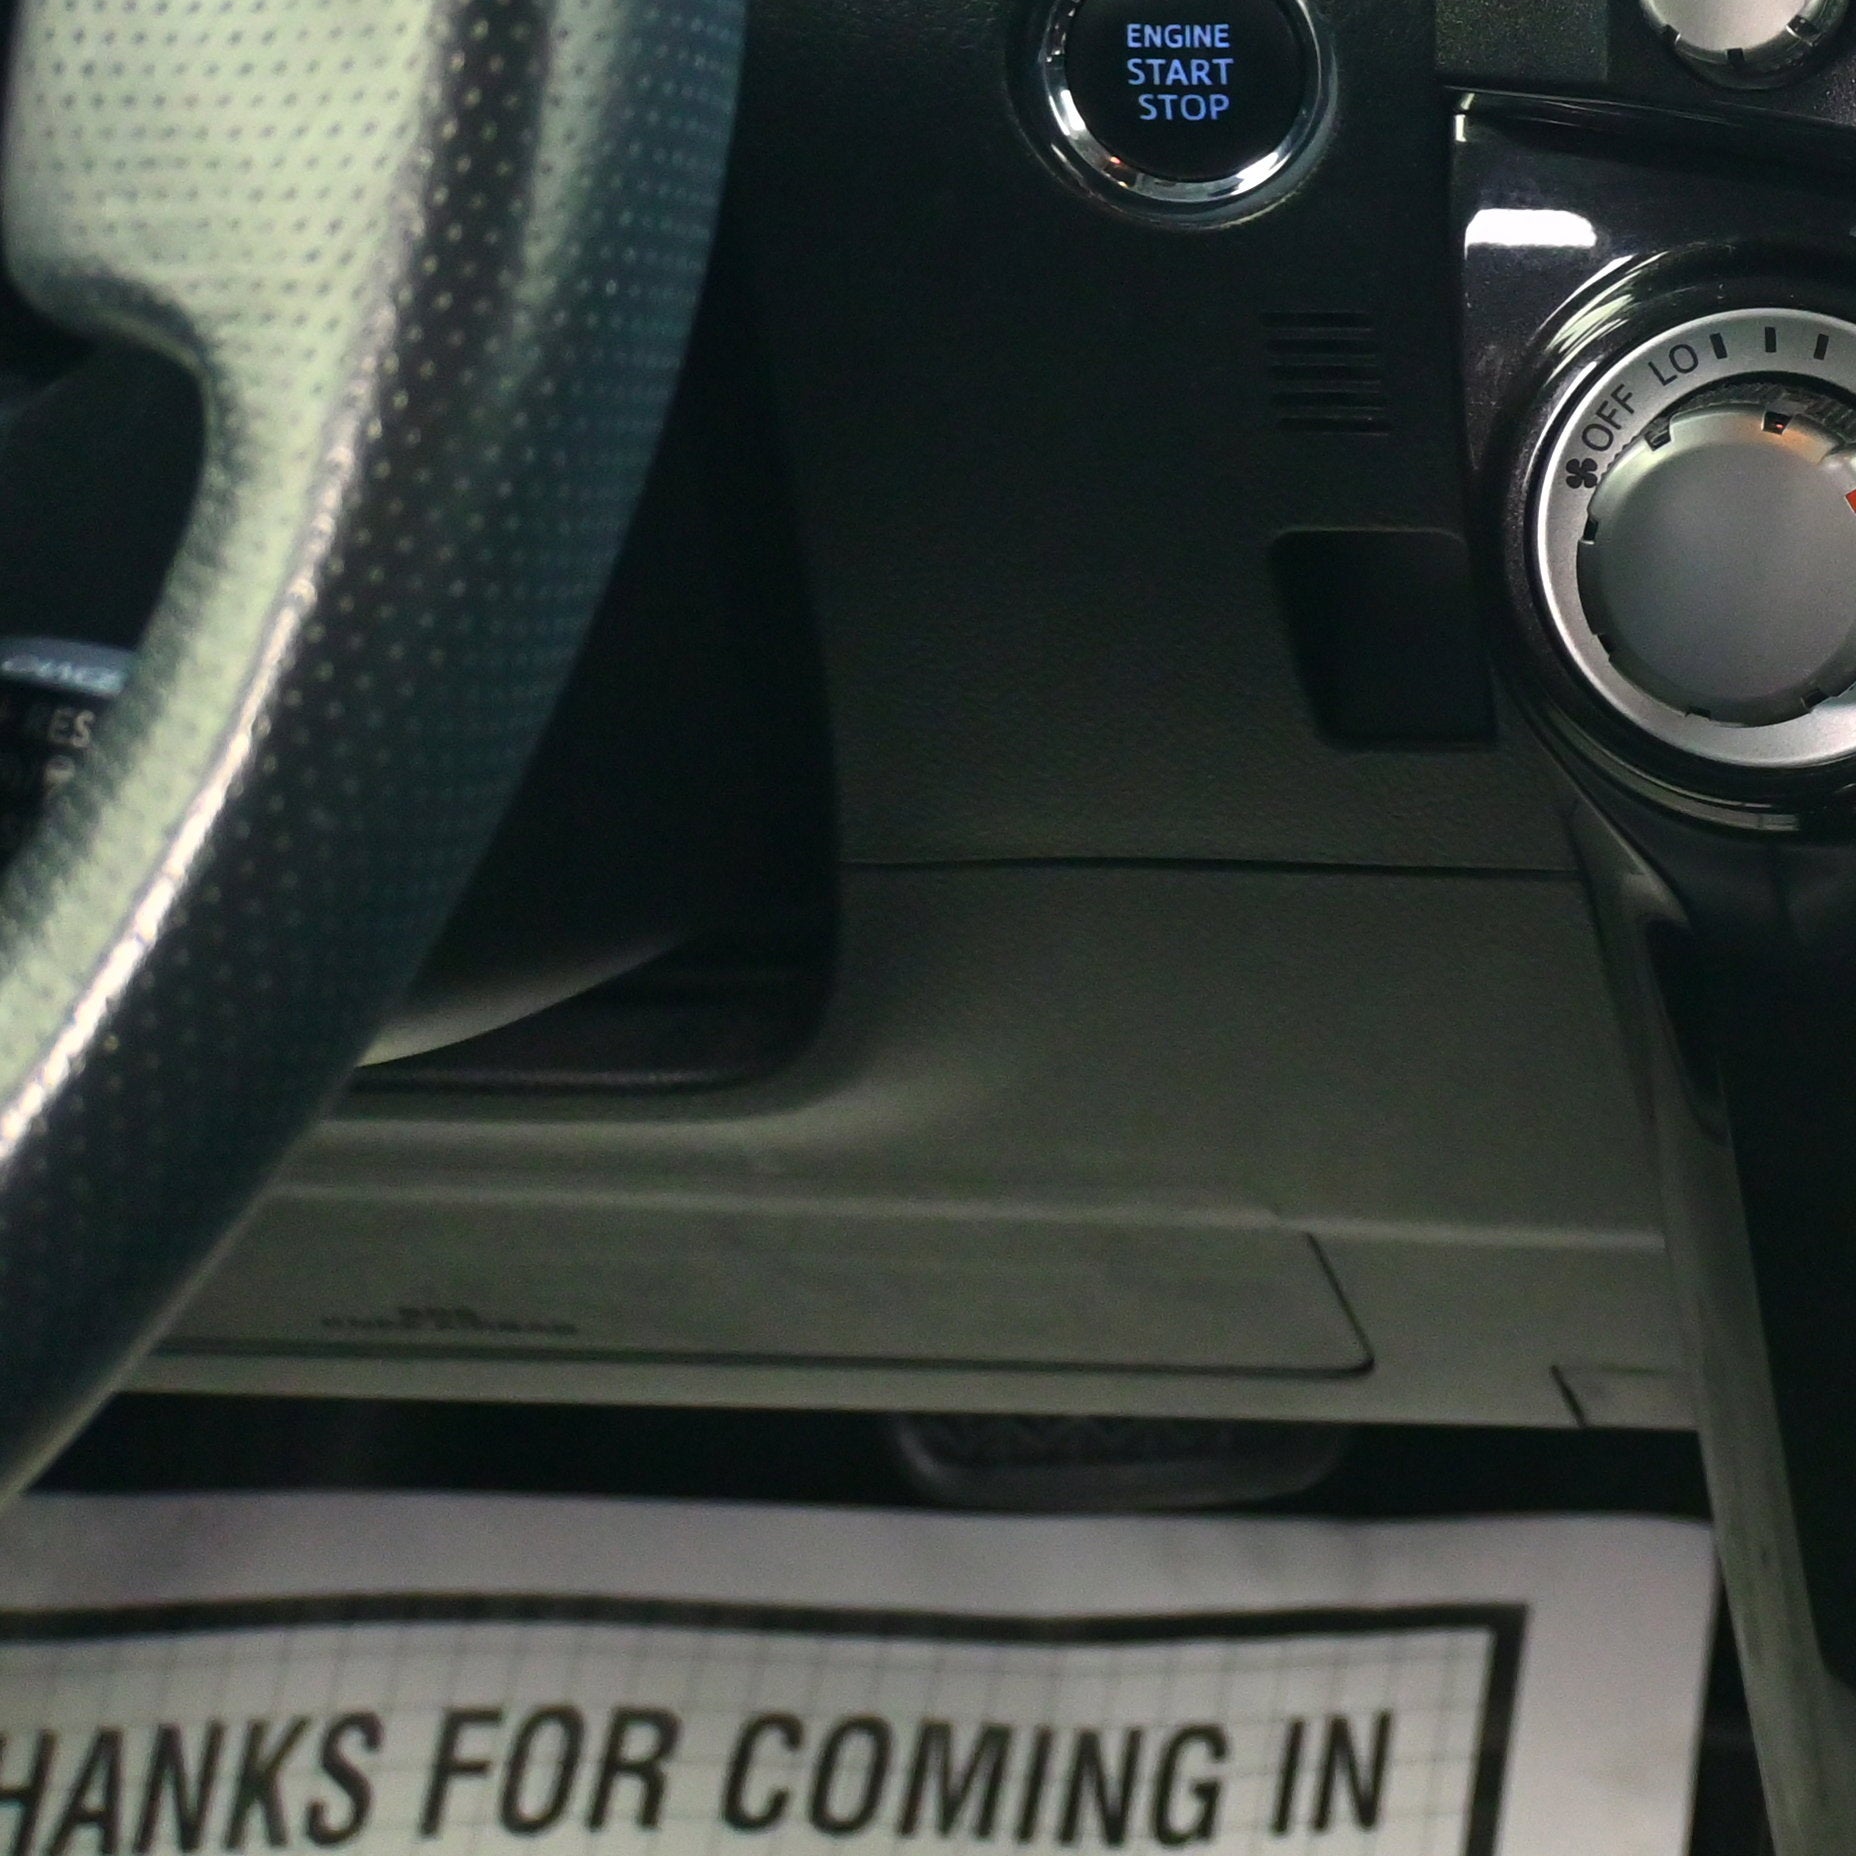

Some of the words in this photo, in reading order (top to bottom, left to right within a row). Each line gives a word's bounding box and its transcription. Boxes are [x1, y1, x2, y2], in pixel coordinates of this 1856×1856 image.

[1126, 23, 1231, 49] ENGINE
[1127, 57, 1234, 86] START
[1138, 93, 1230, 121] STOP
[1580, 383, 1637, 453] OFF
[1647, 343, 1701, 387] LO
[418, 1706, 684, 1840] FOR
[720, 1713, 1226, 1850] COMING
[1270, 1711, 1396, 1836] IN
